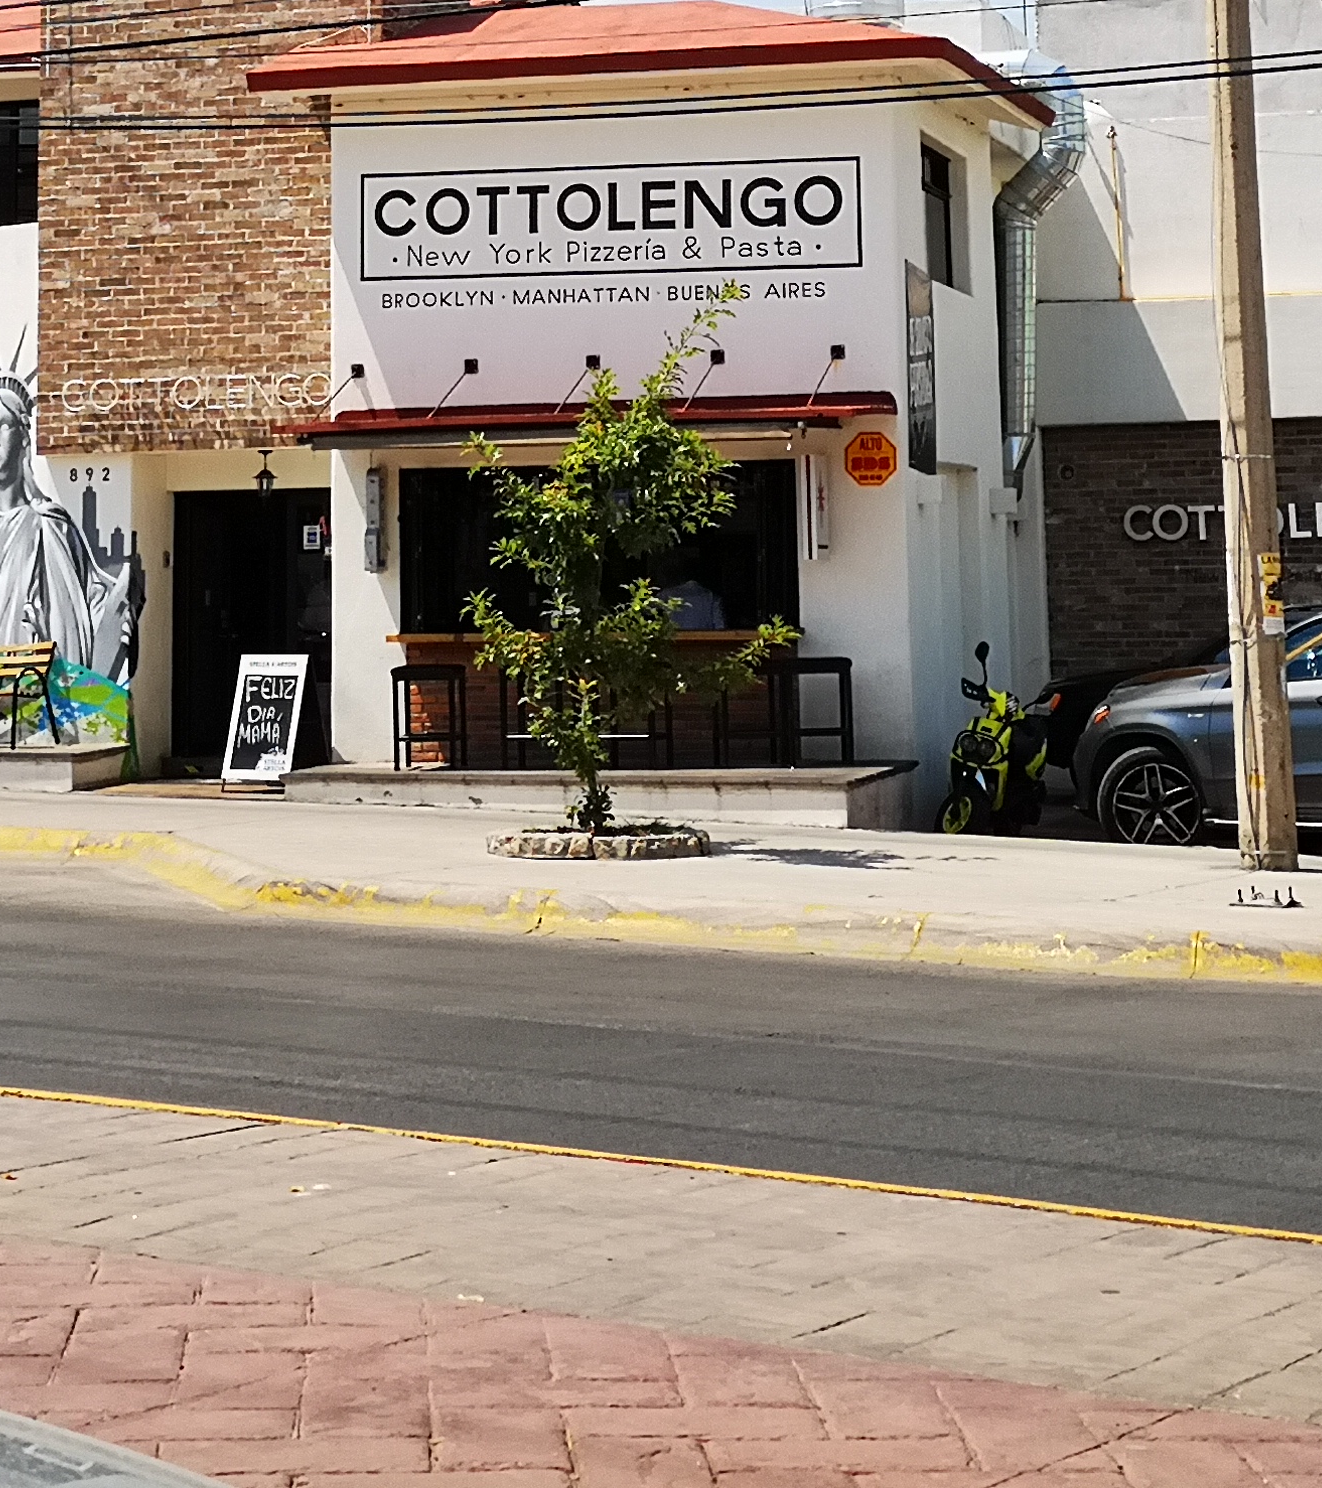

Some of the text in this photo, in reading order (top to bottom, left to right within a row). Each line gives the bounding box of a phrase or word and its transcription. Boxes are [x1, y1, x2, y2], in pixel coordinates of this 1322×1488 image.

[374, 175, 844, 237] COTTOLENGO
[406, 234, 803, 268] New York Pizzería & Pasta
[381, 280, 827, 309] BROOKLYN MANHATTAN BUENS AIRES
[61, 372, 332, 412] COTTOLENGO
[245, 675, 296, 703] FELIZ
